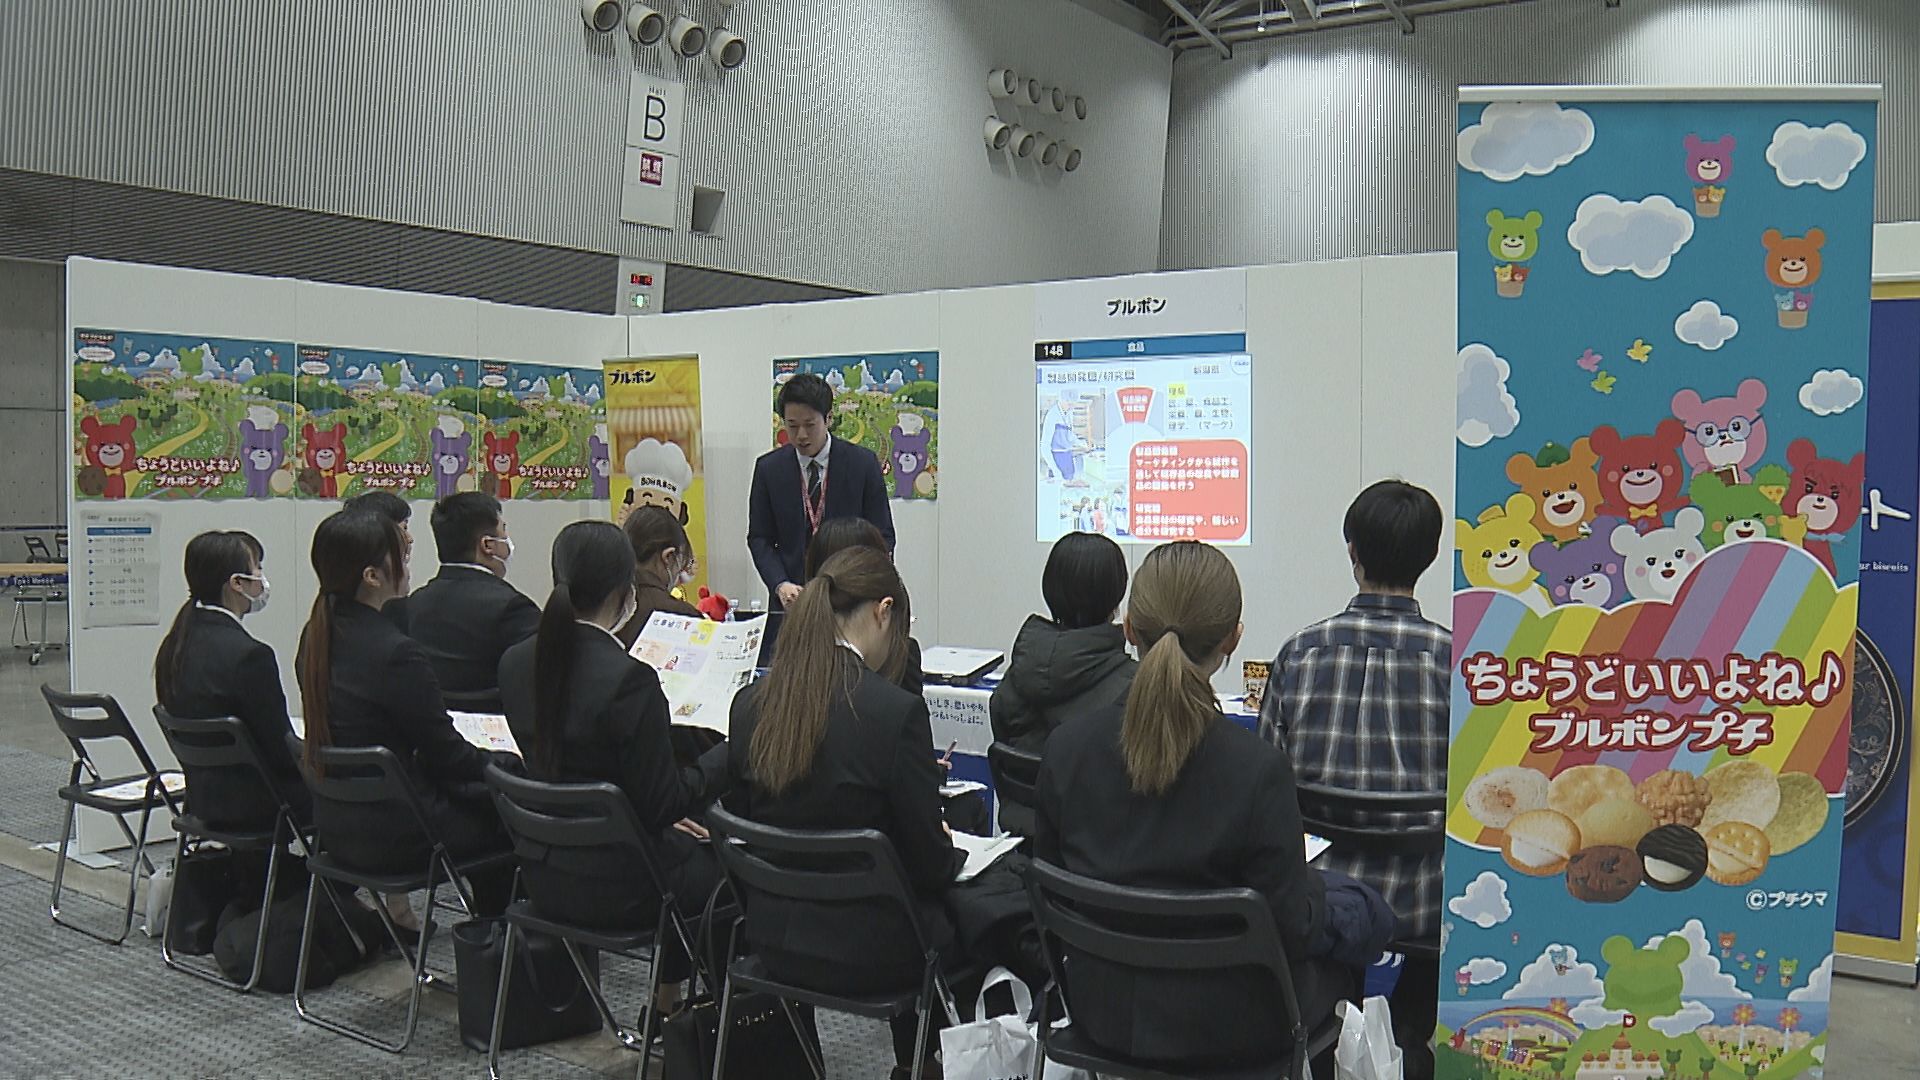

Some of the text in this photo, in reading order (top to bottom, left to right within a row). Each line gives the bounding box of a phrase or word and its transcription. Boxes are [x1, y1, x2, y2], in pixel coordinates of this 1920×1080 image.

[644, 95, 666, 141] B
[1107, 297, 1167, 316] ブルボン
[1043, 344, 1064, 357] 148
[1127, 341, 1145, 353] 食品
[608, 369, 657, 386] ブルボン
